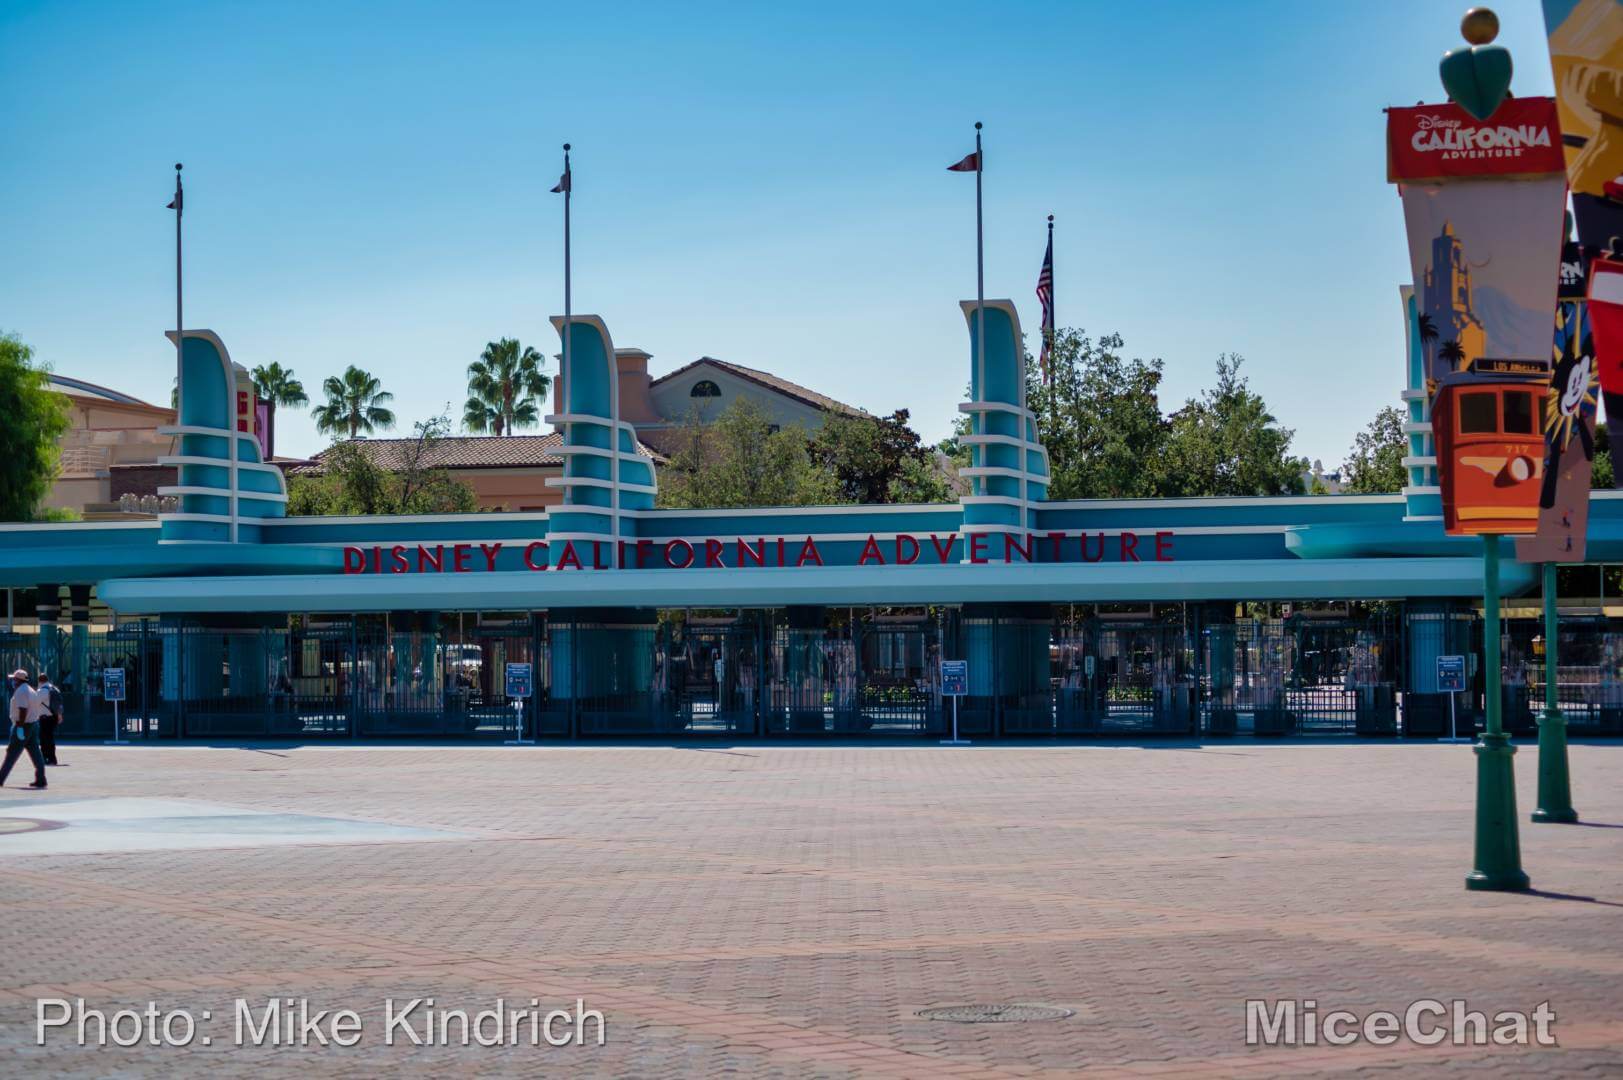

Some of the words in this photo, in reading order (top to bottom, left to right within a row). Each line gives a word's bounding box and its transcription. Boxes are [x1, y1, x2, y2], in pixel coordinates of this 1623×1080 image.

[1415, 114, 1462, 130] Disney
[1411, 126, 1551, 151] CALIFORNIA
[1442, 149, 1521, 159] ADVENTURE
[1505, 445, 1529, 454] 717
[344, 542, 502, 575] DISNEY
[524, 535, 823, 570] CALIFORNIA
[858, 531, 1174, 564] ADVENTURE
